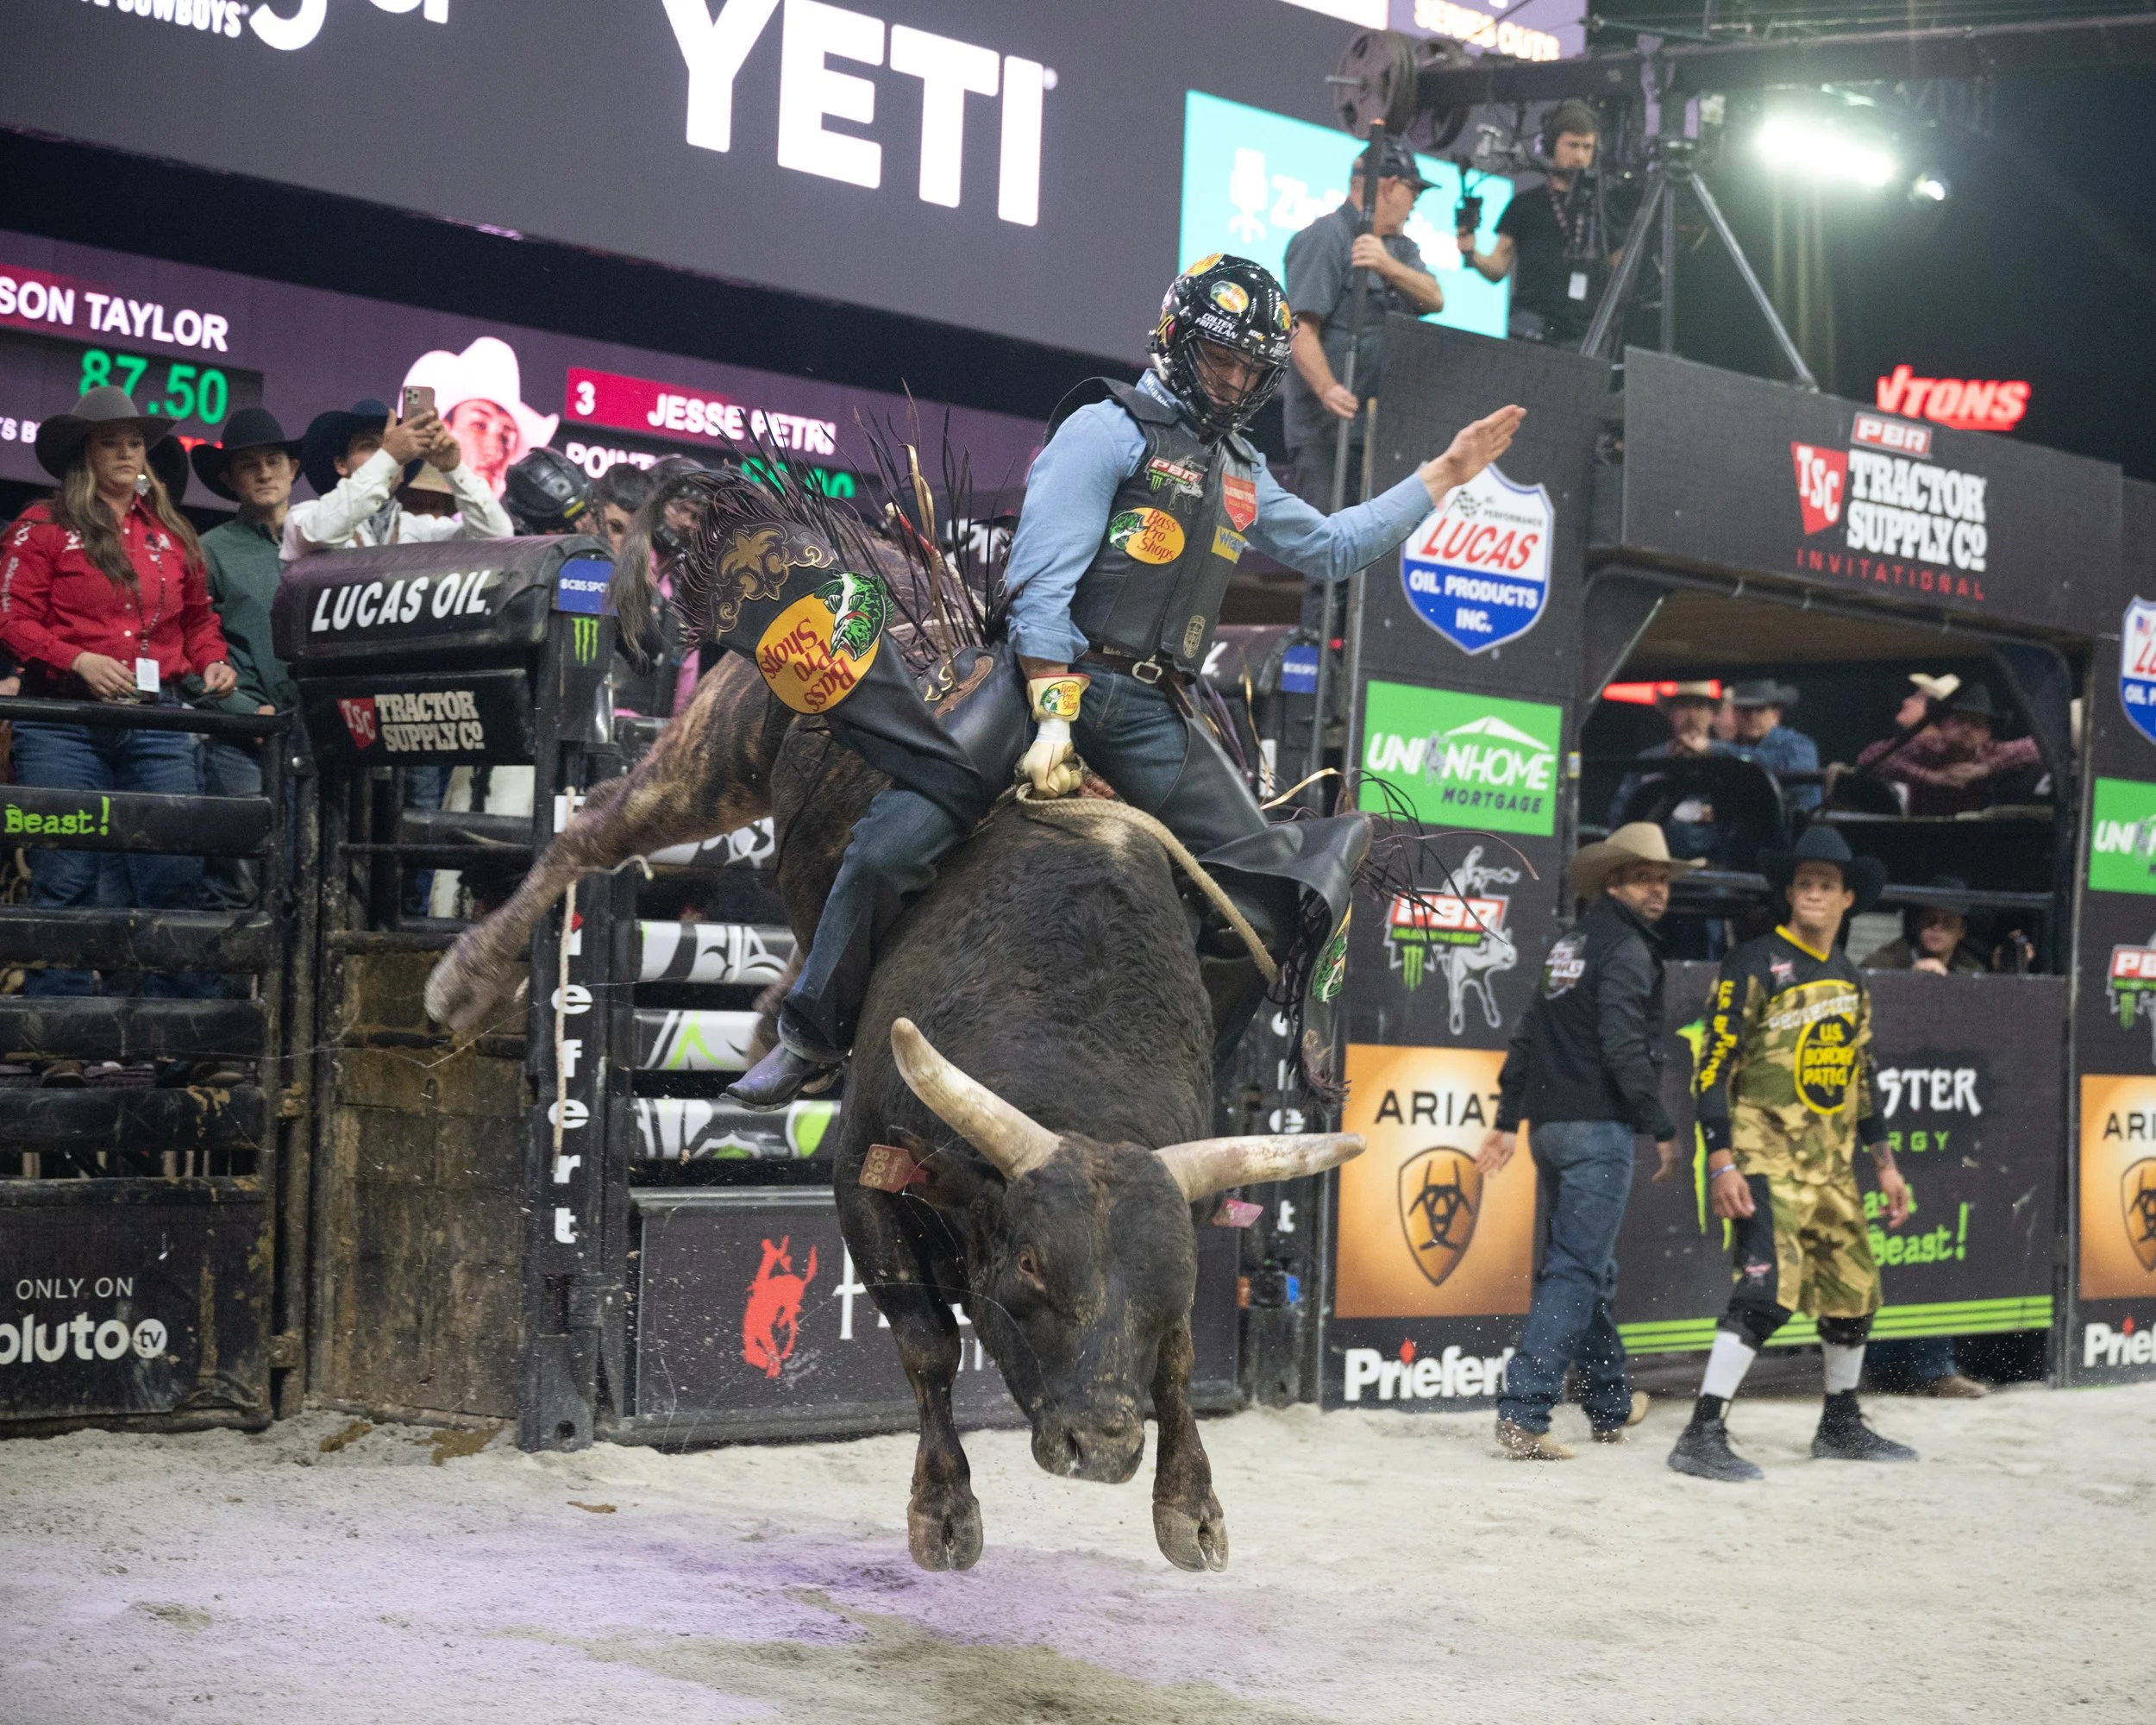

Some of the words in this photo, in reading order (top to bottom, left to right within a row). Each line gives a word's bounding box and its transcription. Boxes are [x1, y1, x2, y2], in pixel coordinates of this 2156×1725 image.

[661, 0, 1045, 227] YETI
[85, 292, 229, 353] TAYLOR
[1194, 317, 1238, 340] FRITZLAN
[1201, 312, 1236, 330] COLTEN
[78, 348, 229, 425] 87.50
[574, 380, 596, 416] 3
[647, 393, 746, 442] JESSE
[750, 410, 837, 456] PETRI
[1857, 417, 1927, 453] PBR
[1150, 458, 1200, 482] PBR
[1796, 445, 1839, 523] TSC
[1848, 448, 1987, 524] TRACTOR
[1143, 525, 1167, 543] Pro
[1146, 509, 1178, 532] Bass
[1846, 499, 1953, 566] SUPPLY
[1137, 536, 1175, 561] Shops
[1420, 518, 1539, 570] LUCAS
[1409, 568, 1441, 594] OIL
[1445, 574, 1539, 611] PRODUCTS
[1796, 546, 1984, 602] INVITATIONAL
[311, 576, 429, 632] LUCAS
[1456, 607, 1493, 633] INC.
[760, 617, 818, 680] Shops
[793, 638, 836, 682] Pro
[804, 656, 856, 712] Bass
[342, 699, 376, 741] TSC
[375, 691, 479, 723] TRACTOR
[381, 723, 461, 752] SUPPLY
[4, 796, 110, 836] Beast!
[1442, 787, 1544, 814] MORTGAGE
[1395, 894, 1501, 929] PBR
[1877, 1067, 1983, 1119] STER
[1871, 1130, 1951, 1153] RGY
[16, 1278, 85, 1300] ONLY
[95, 1276, 133, 1297] ON
